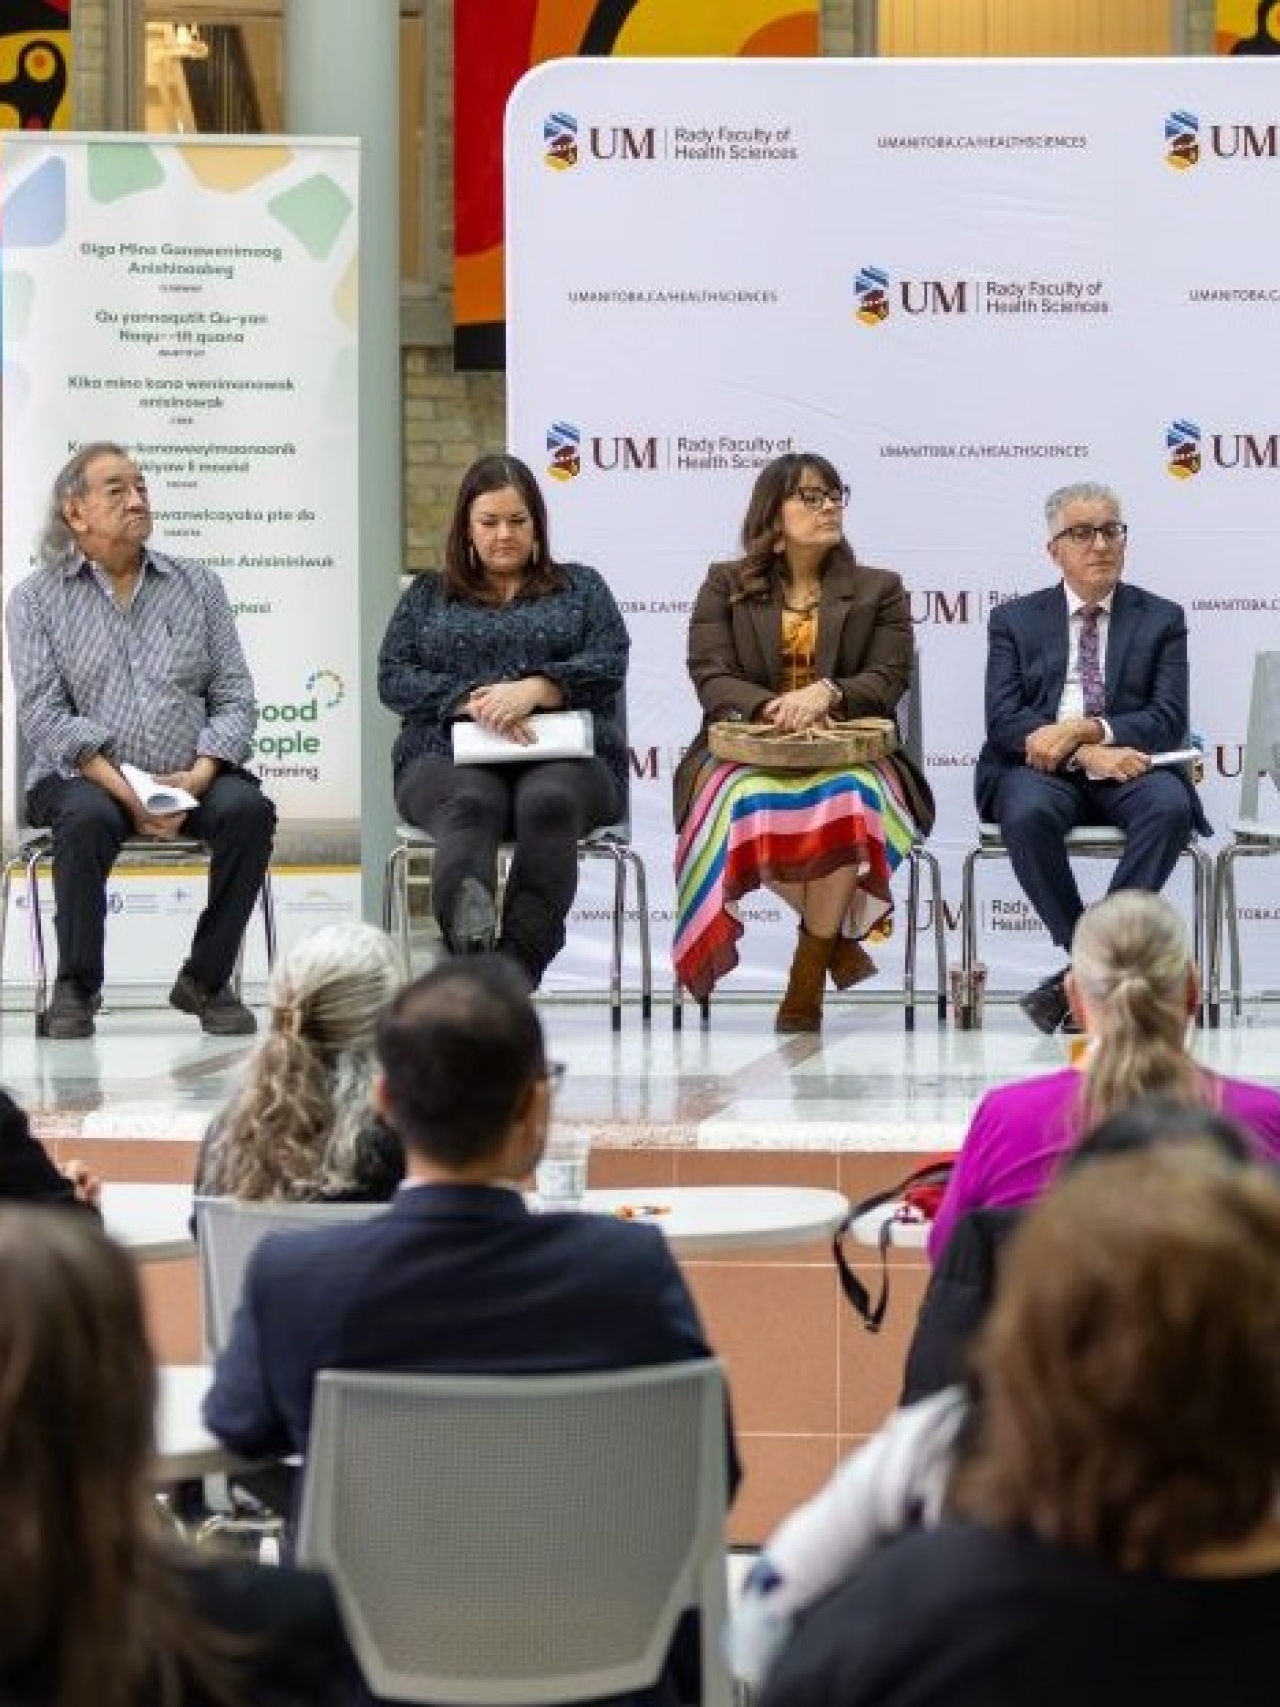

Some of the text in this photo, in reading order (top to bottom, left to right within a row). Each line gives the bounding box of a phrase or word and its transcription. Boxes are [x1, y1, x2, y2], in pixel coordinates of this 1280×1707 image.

[675, 127, 791, 142] Rady Faculty of
[877, 136, 1087, 148] UMANITOBA.CA/HEALTHSCIENCES
[1210, 125, 1278, 157] UM
[590, 128, 656, 160] UM
[675, 145, 798, 159] Health Sciences
[569, 289, 778, 301] UMANITOBA.CA/HEALTHSCIENCES
[987, 281, 1102, 297] Rady Faculty of
[900, 281, 968, 315] UM
[987, 299, 1109, 313] Health Sciences
[678, 437, 793, 453] Rady Faculty of
[880, 445, 1089, 457] UMANITOBA.CA/HEALTHSCIENCES
[1210, 435, 1280, 468] UM
[591, 437, 659, 470] UM
[678, 455, 765, 469] Health Scie
[904, 591, 971, 624] UM
[255, 698, 318, 722] ood
[257, 763, 320, 782] Training
